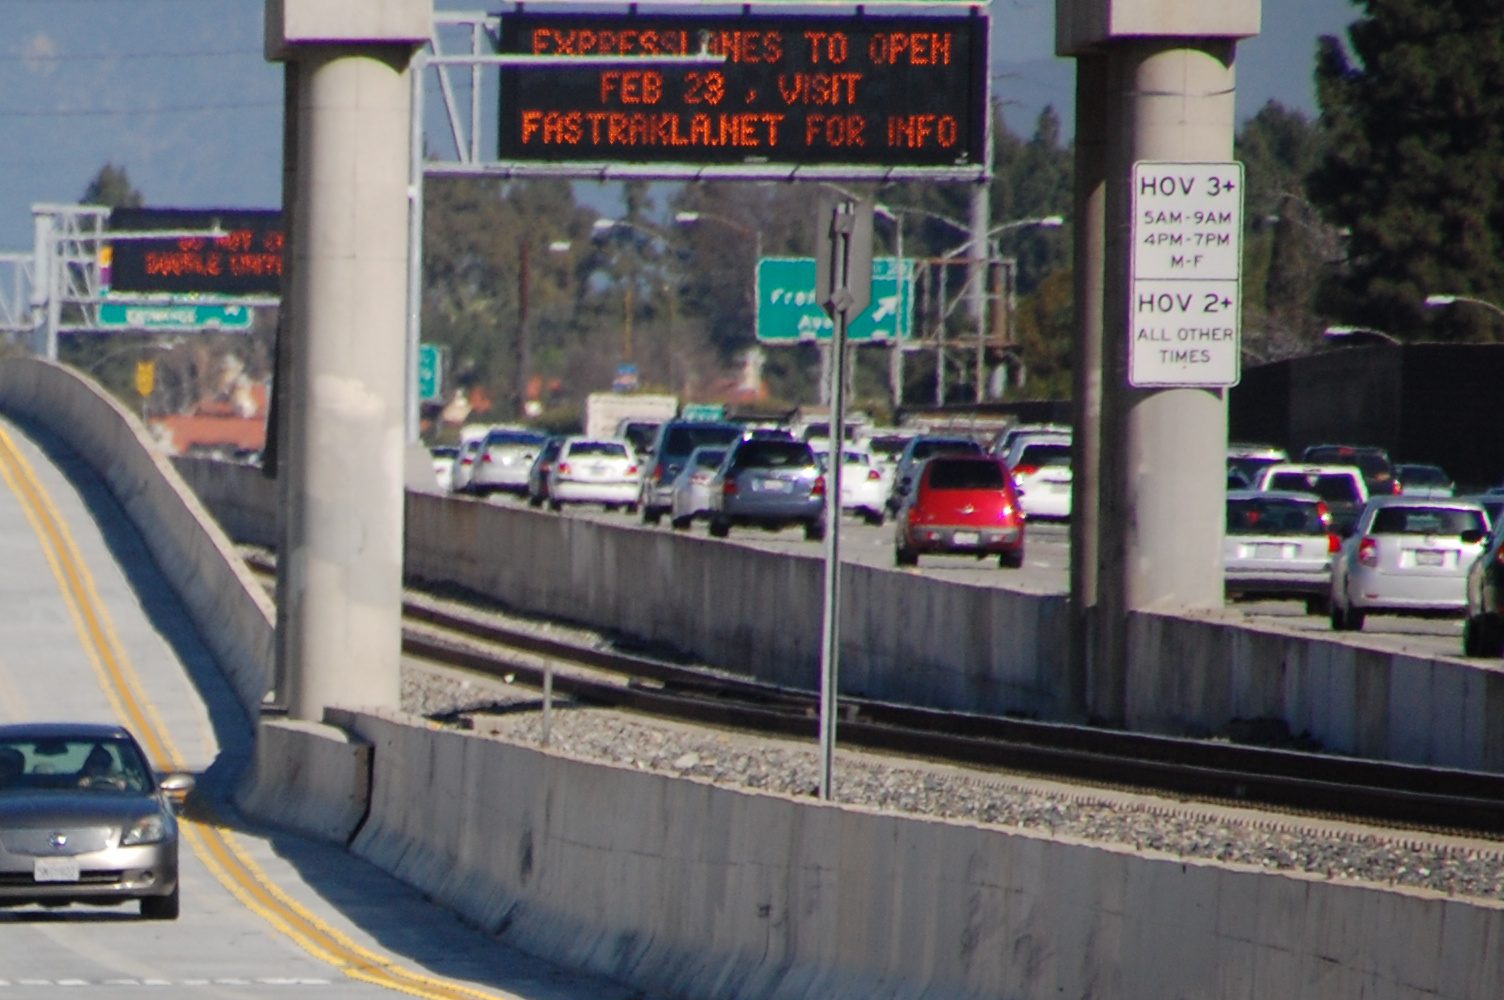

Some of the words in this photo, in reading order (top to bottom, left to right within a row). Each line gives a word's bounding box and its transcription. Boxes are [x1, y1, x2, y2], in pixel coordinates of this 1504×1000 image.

[804, 31, 849, 65] TO
[868, 31, 953, 66] OPEN
[600, 70, 663, 104] FEB
[777, 71, 864, 106] VISIT
[805, 112, 866, 147] FOR
[887, 112, 959, 149] INFO
[1140, 176, 1195, 196] HOV
[1207, 176, 1236, 197] 3+
[1138, 293, 1193, 313] HOV
[1203, 293, 1233, 313] 2+
[1137, 328, 1171, 342] ALL
[1177, 328, 1234, 342] OTHER
[1159, 349, 1211, 364] TIMES
